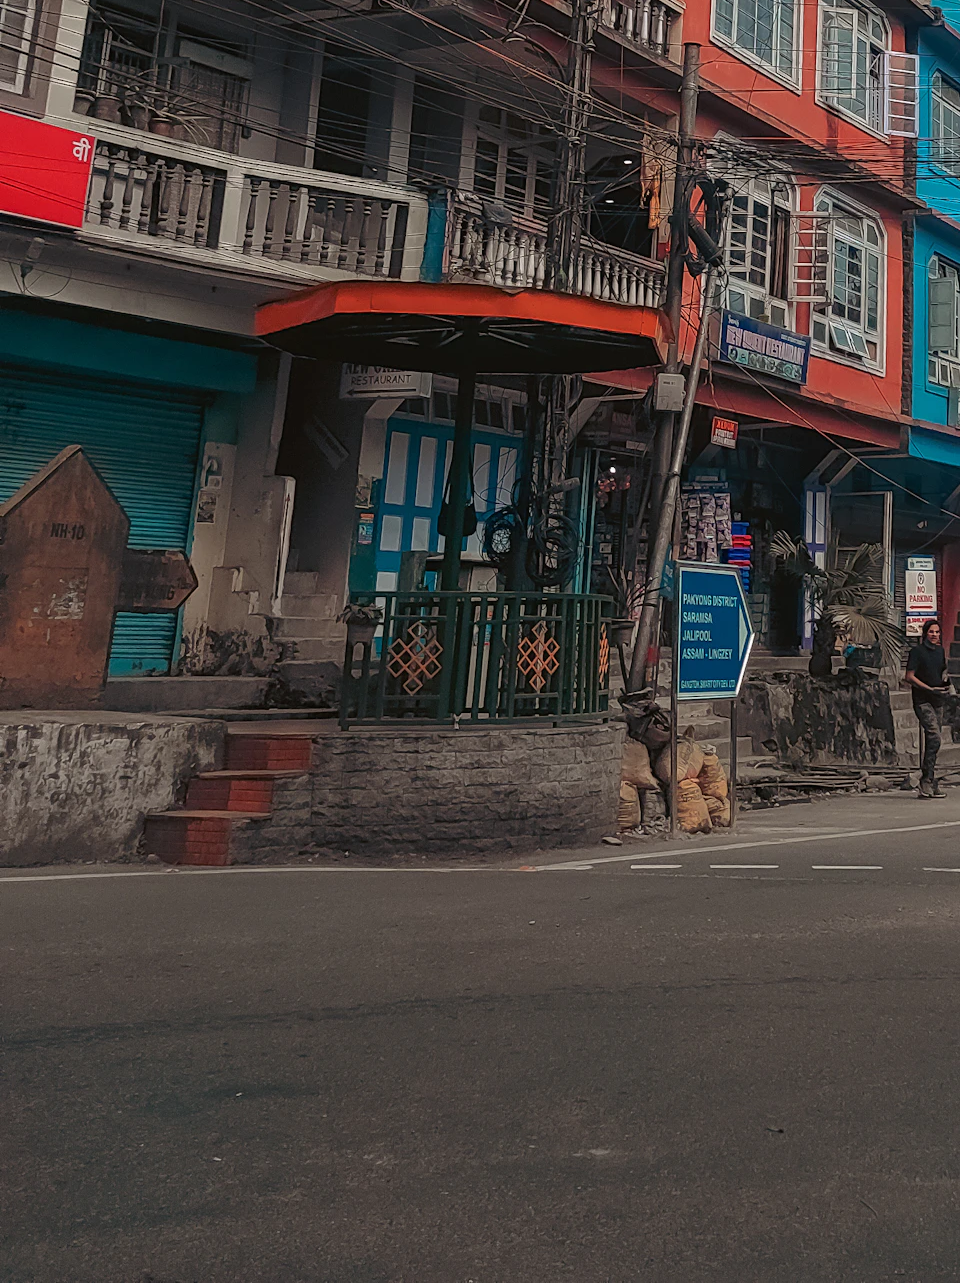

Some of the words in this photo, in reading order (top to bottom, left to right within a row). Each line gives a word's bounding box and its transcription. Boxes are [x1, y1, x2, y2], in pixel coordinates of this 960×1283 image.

[351, 374, 412, 386] RESTAURANT
[51, 523, 84, 540] NH-10
[917, 585, 926, 594] NO
[683, 593, 712, 606] PAKYONG
[712, 596, 738, 607] DISTRICT
[909, 595, 933, 603] PARKING
[683, 611, 713, 624] SARAMSA
[682, 630, 713, 641] JALIPOOL
[681, 648, 705, 660] ASSAM
[708, 648, 733, 660] LINGZEY
